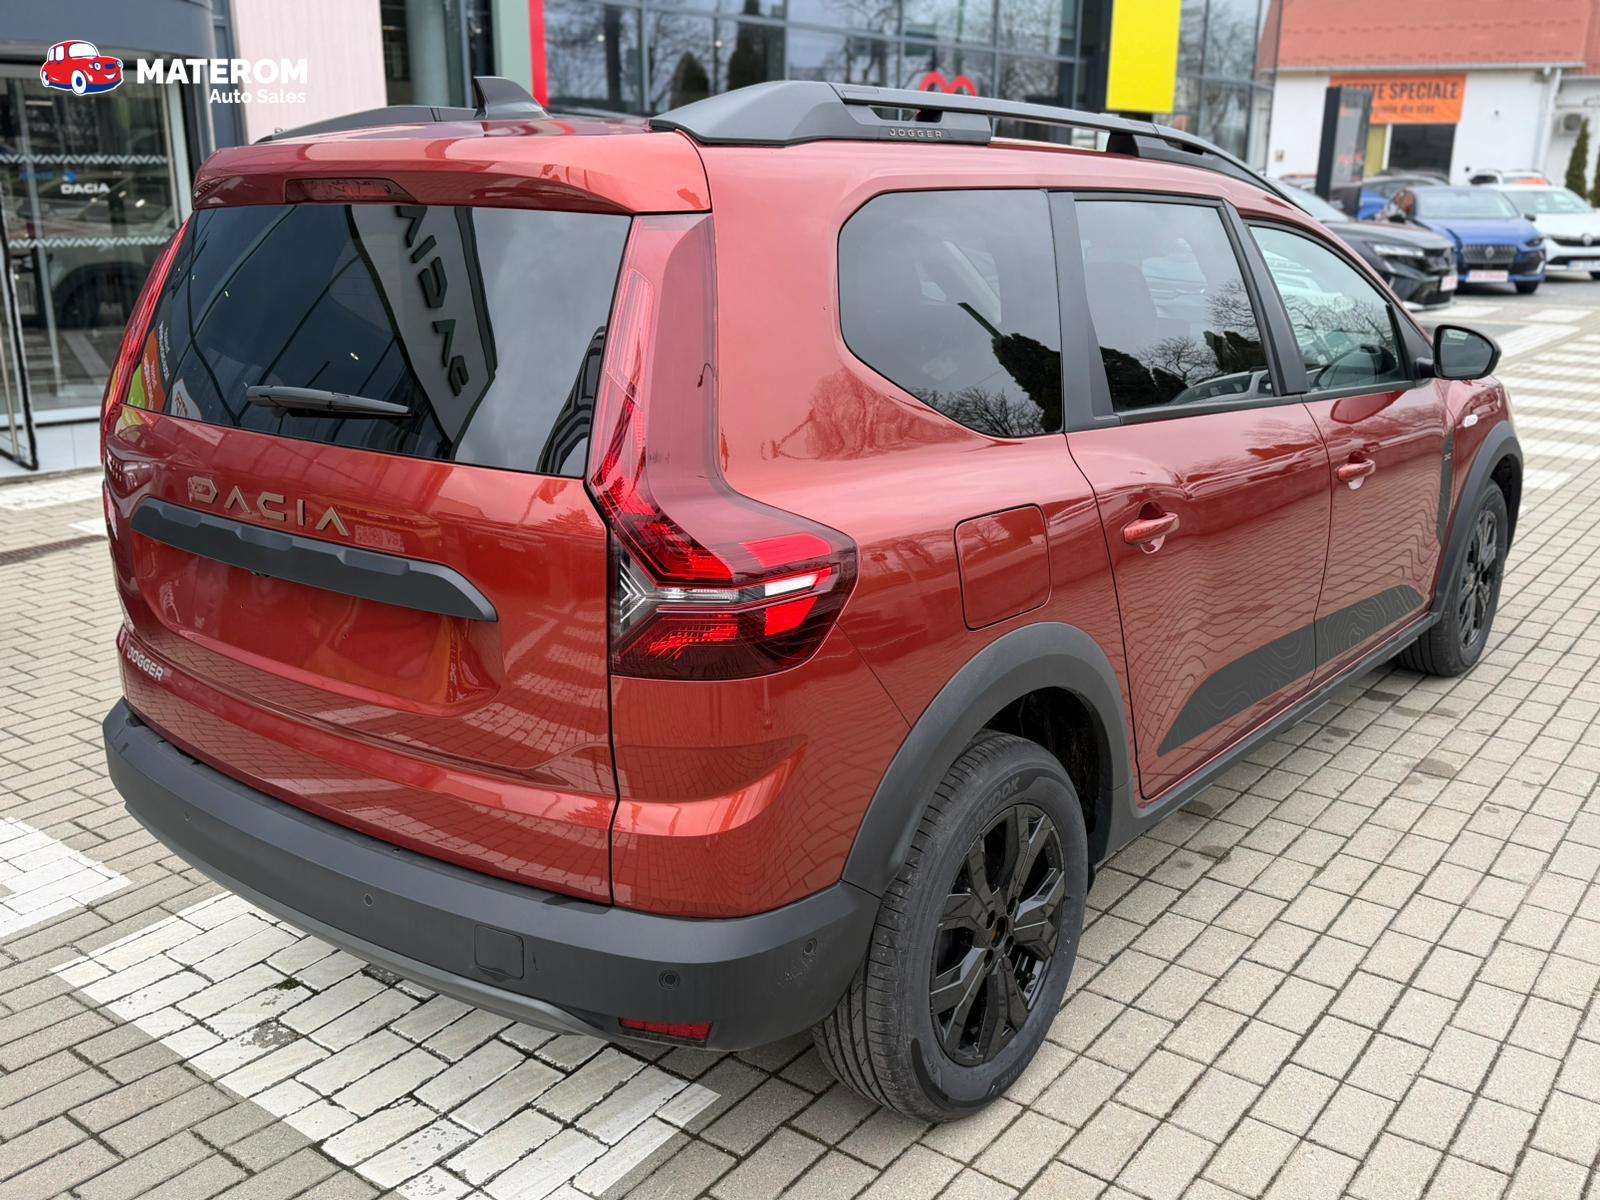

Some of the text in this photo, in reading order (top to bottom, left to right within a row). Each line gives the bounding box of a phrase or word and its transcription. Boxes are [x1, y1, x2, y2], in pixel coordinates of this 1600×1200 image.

[1389, 81, 1459, 100] SPECIALE
[889, 128, 942, 138] JOGGER
[60, 182, 110, 195] DACIA
[187, 475, 350, 537] DACIA
[127, 646, 164, 681] JOGGER
